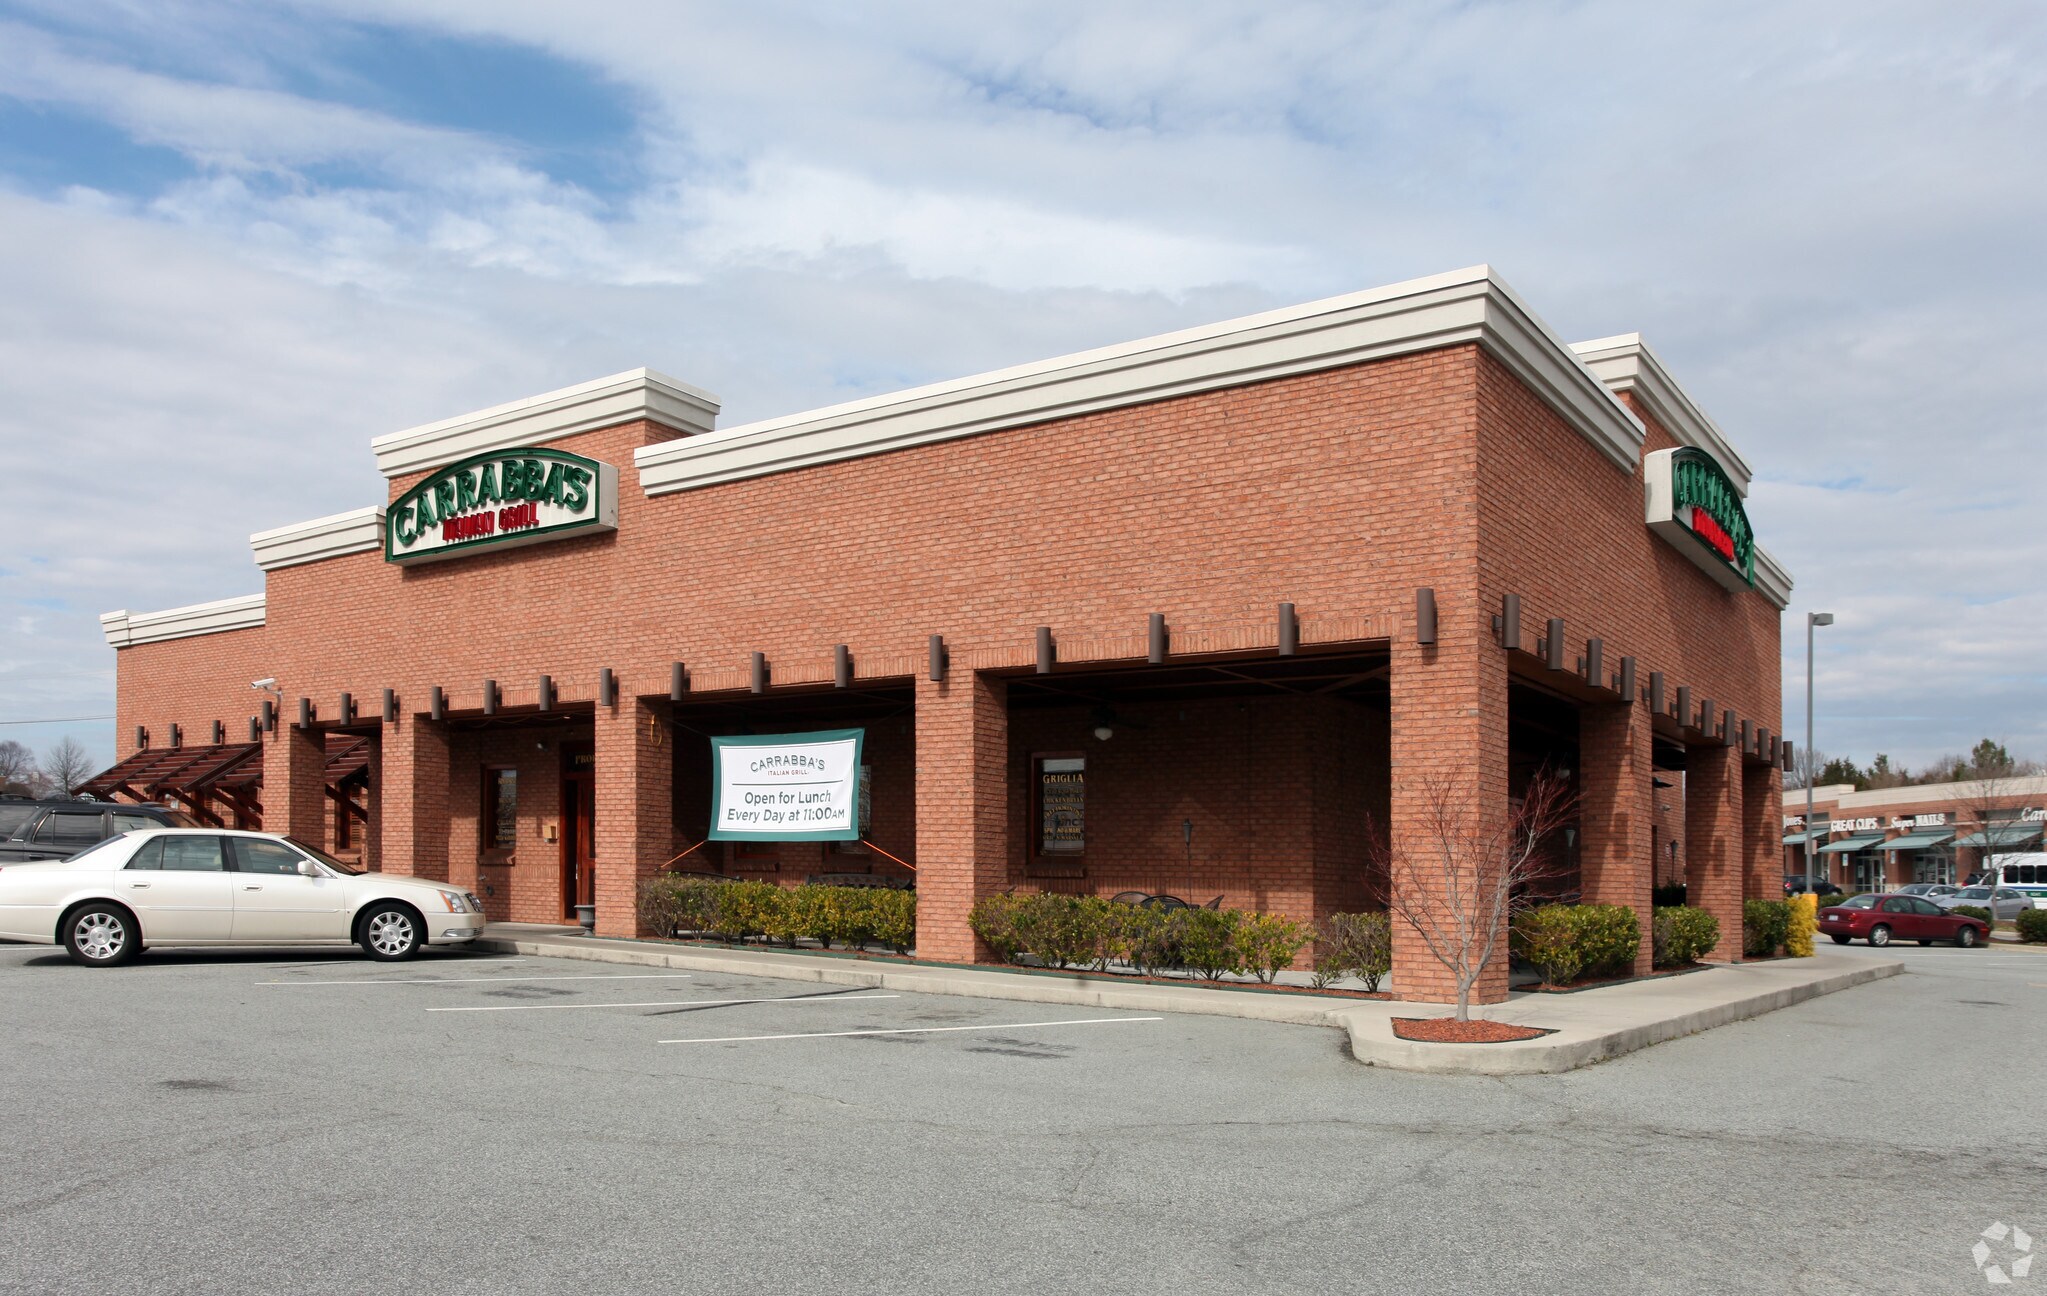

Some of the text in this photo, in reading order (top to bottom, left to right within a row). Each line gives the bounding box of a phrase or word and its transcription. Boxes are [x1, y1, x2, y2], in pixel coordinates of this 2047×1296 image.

[395, 459, 592, 545] CARRABBA'S
[499, 502, 540, 531] GRILL
[750, 754, 825, 772] CARRABBA'S
[1043, 774, 1083, 783] GRIGLIA
[744, 790, 831, 805] Open for Lunch
[727, 807, 845, 823] Every Day at 11:00AM
[1915, 813, 1946, 827] NAILS
[1830, 817, 1878, 832] GREAT CLIPS
